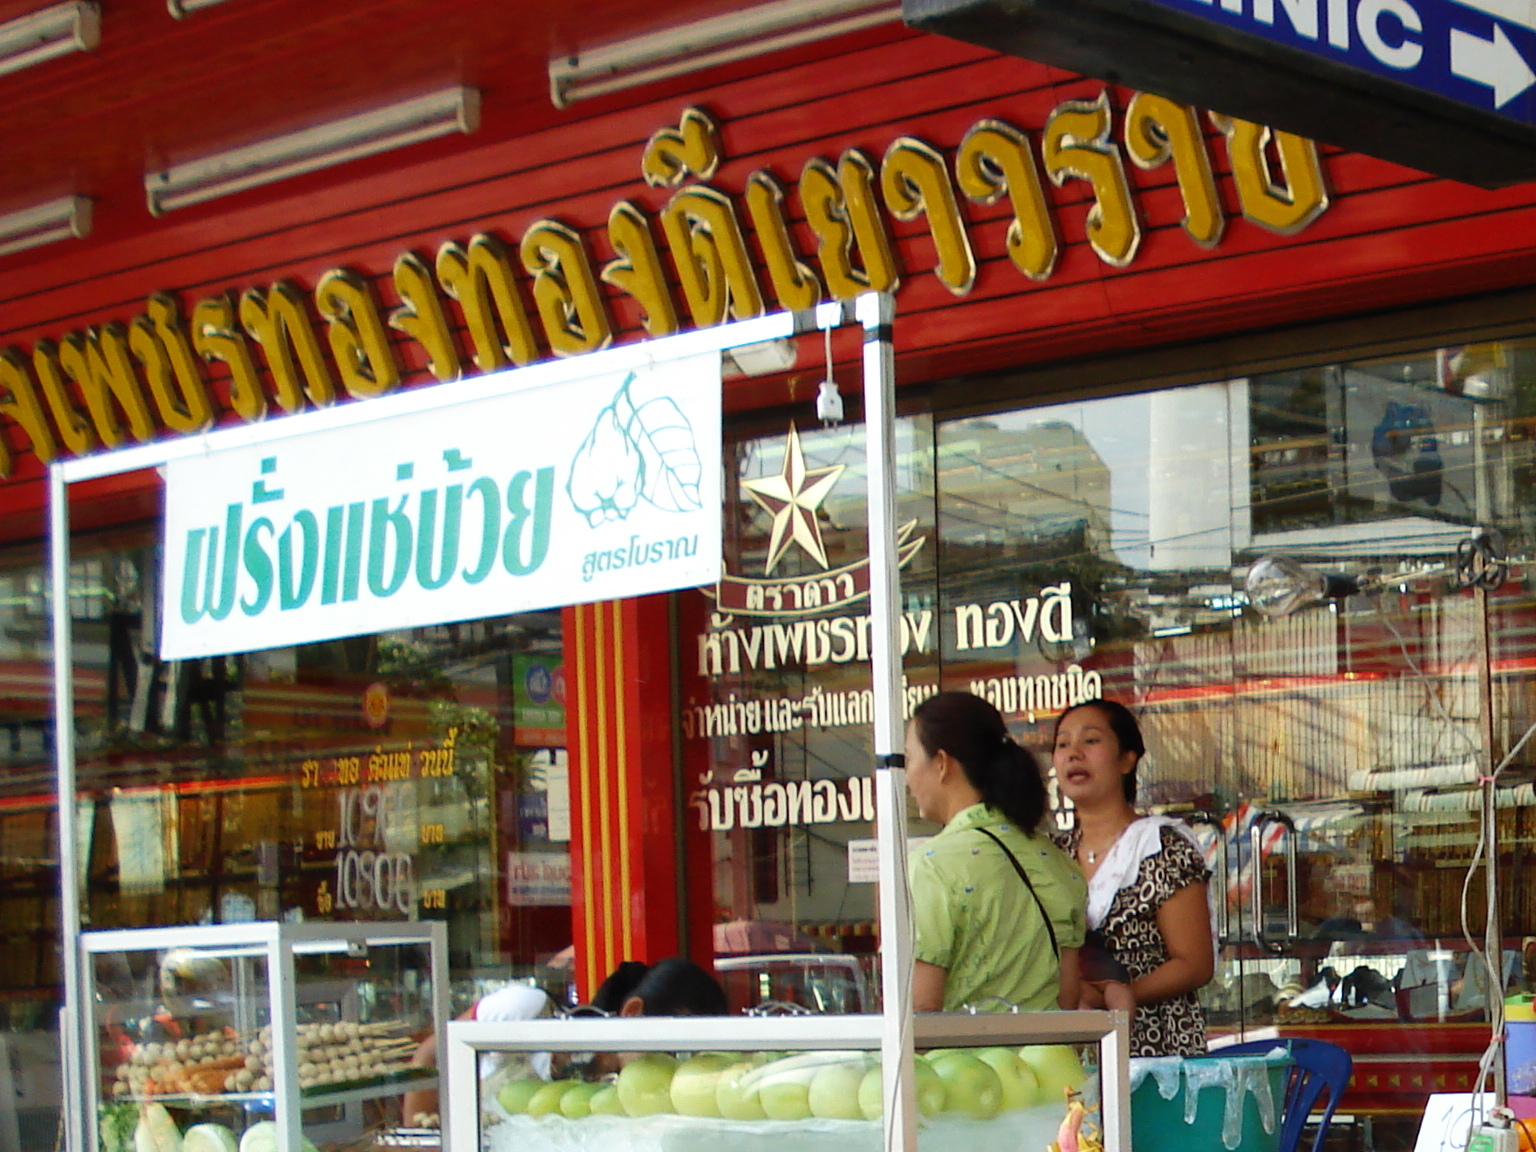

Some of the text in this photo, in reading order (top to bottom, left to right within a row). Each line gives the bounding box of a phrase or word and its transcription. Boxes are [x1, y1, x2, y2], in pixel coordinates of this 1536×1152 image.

[581, 534, 699, 583] สูตรโบราณ
[745, 572, 855, 611] ตราดาว
[956, 582, 1075, 652] ทองดี
